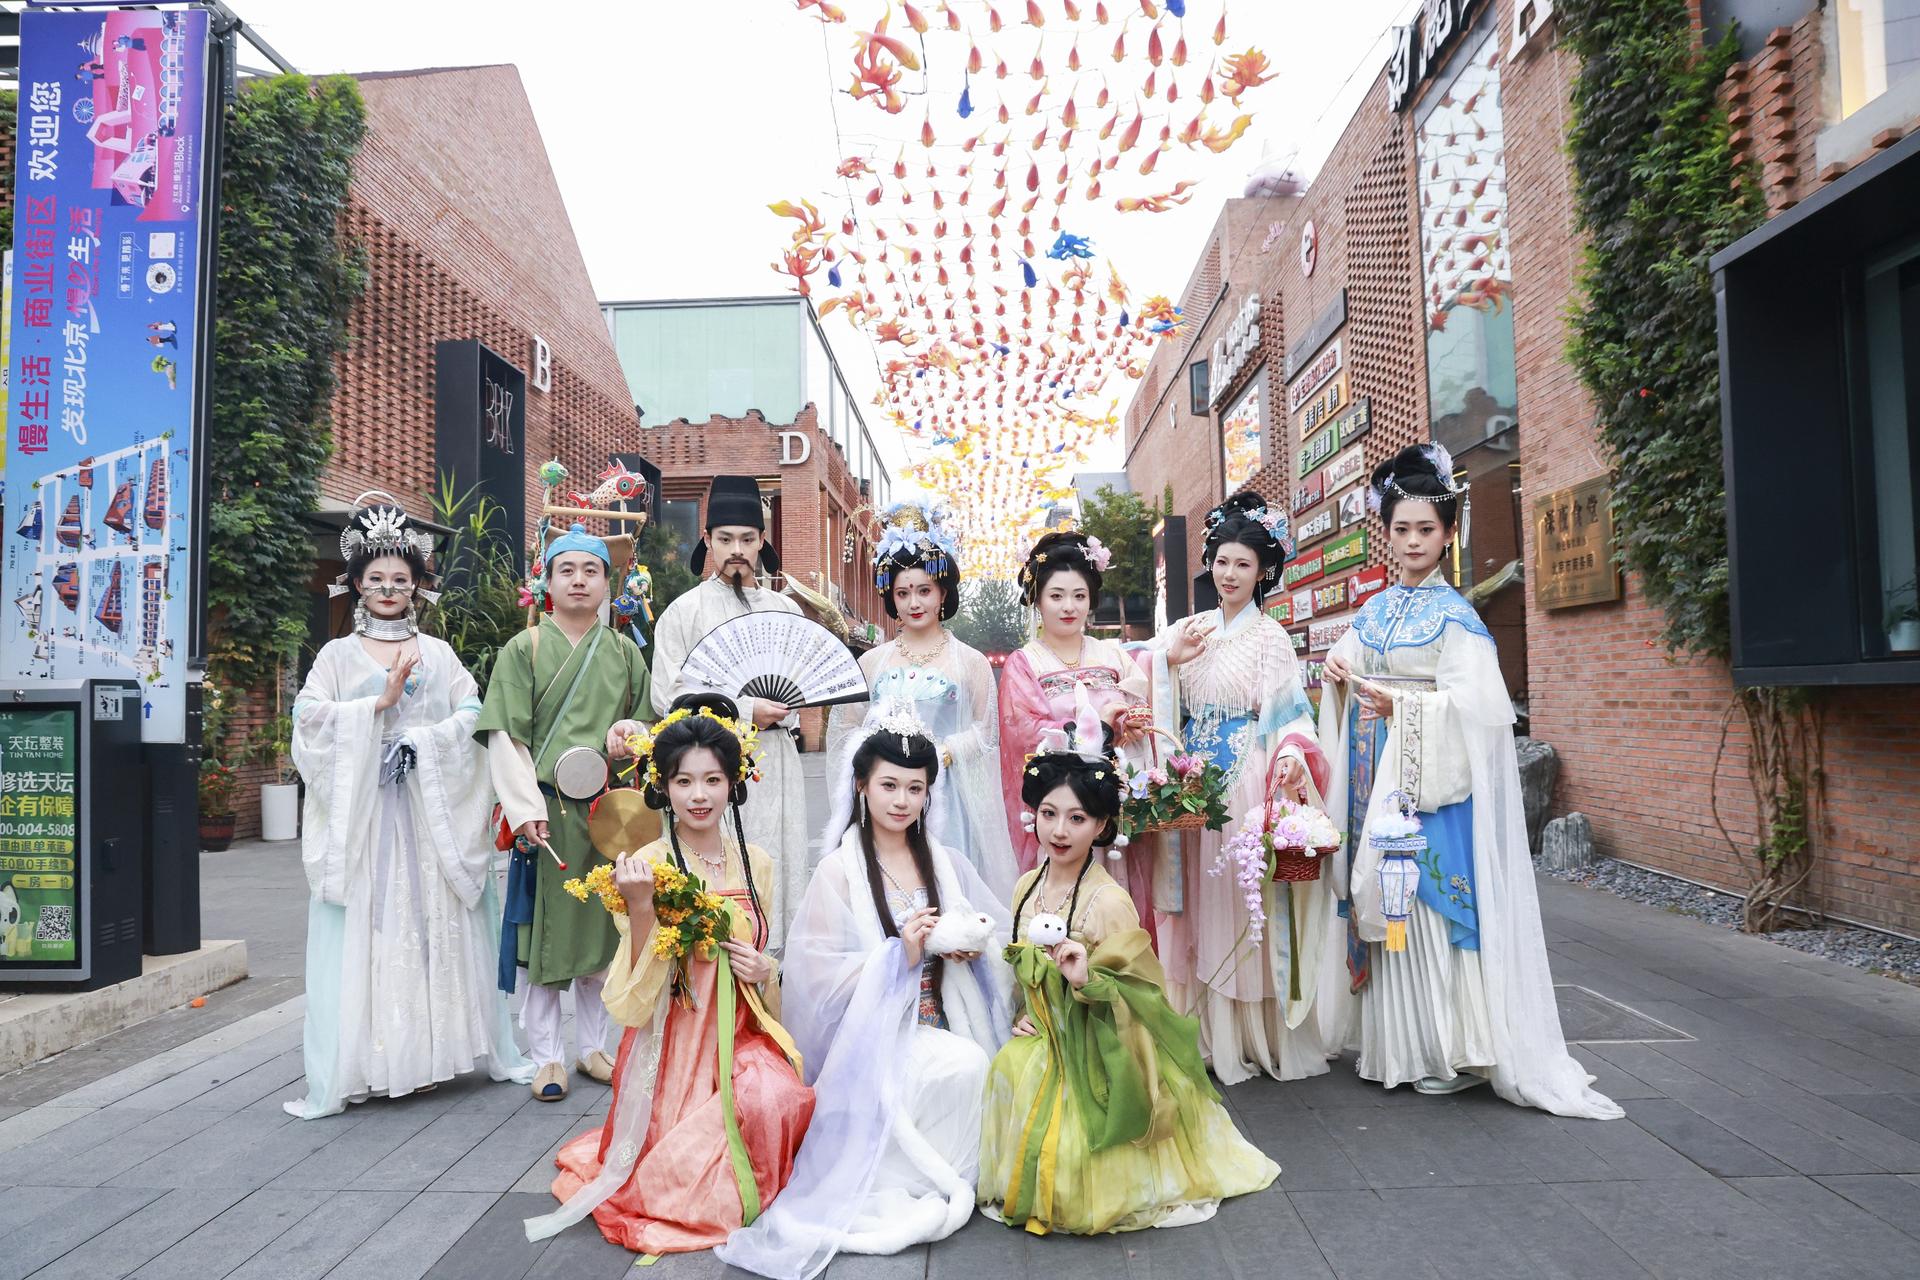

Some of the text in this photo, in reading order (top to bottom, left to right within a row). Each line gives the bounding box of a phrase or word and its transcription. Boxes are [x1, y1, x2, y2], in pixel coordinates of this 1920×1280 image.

[27, 81, 61, 181] 欢迎您
[534, 334, 551, 393] B
[778, 431, 811, 465] D
[8, 736, 64, 751] 天坛整装
[10, 751, 23, 759] TIN
[26, 751, 41, 759] TAN
[0, 771, 74, 793] 修选天坛
